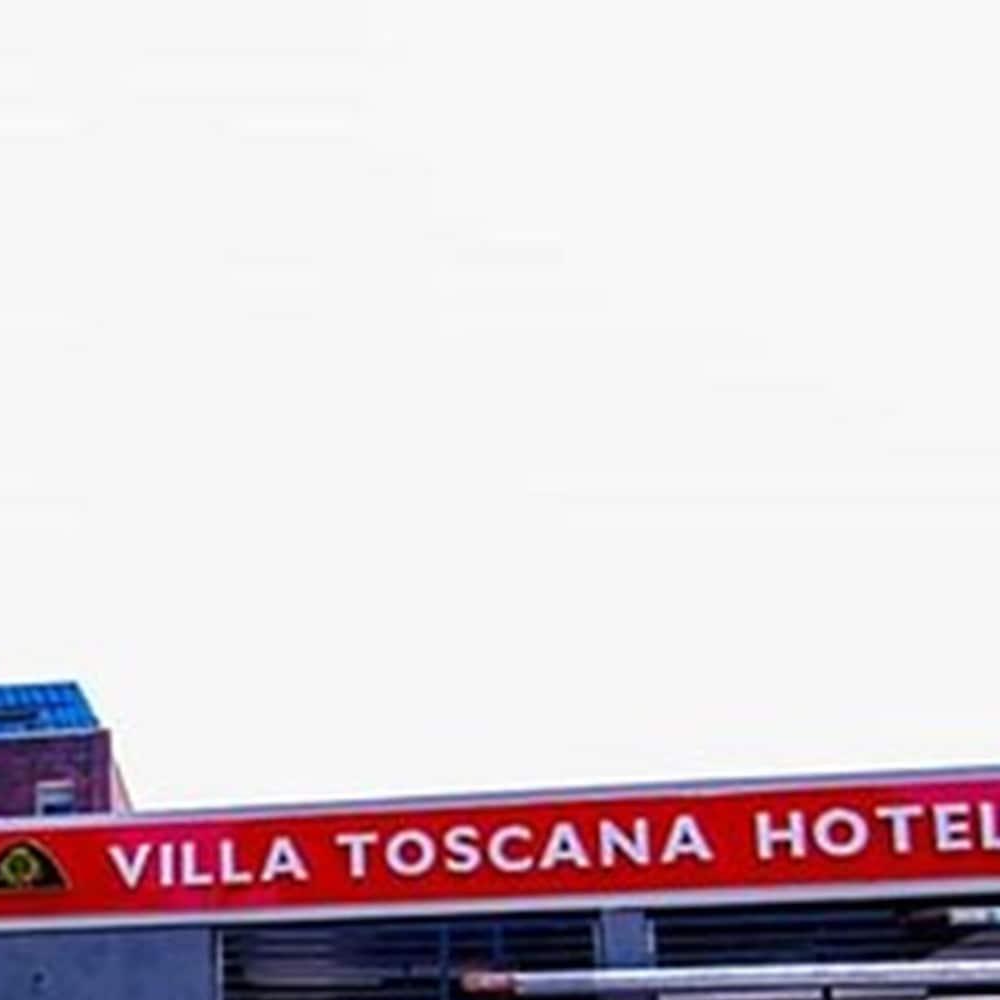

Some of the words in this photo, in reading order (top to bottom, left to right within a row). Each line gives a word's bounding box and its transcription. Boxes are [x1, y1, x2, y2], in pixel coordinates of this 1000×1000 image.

[107, 836, 309, 889] VILLA
[335, 813, 714, 880] TOSCANA
[755, 801, 1000, 860] HOTEL
